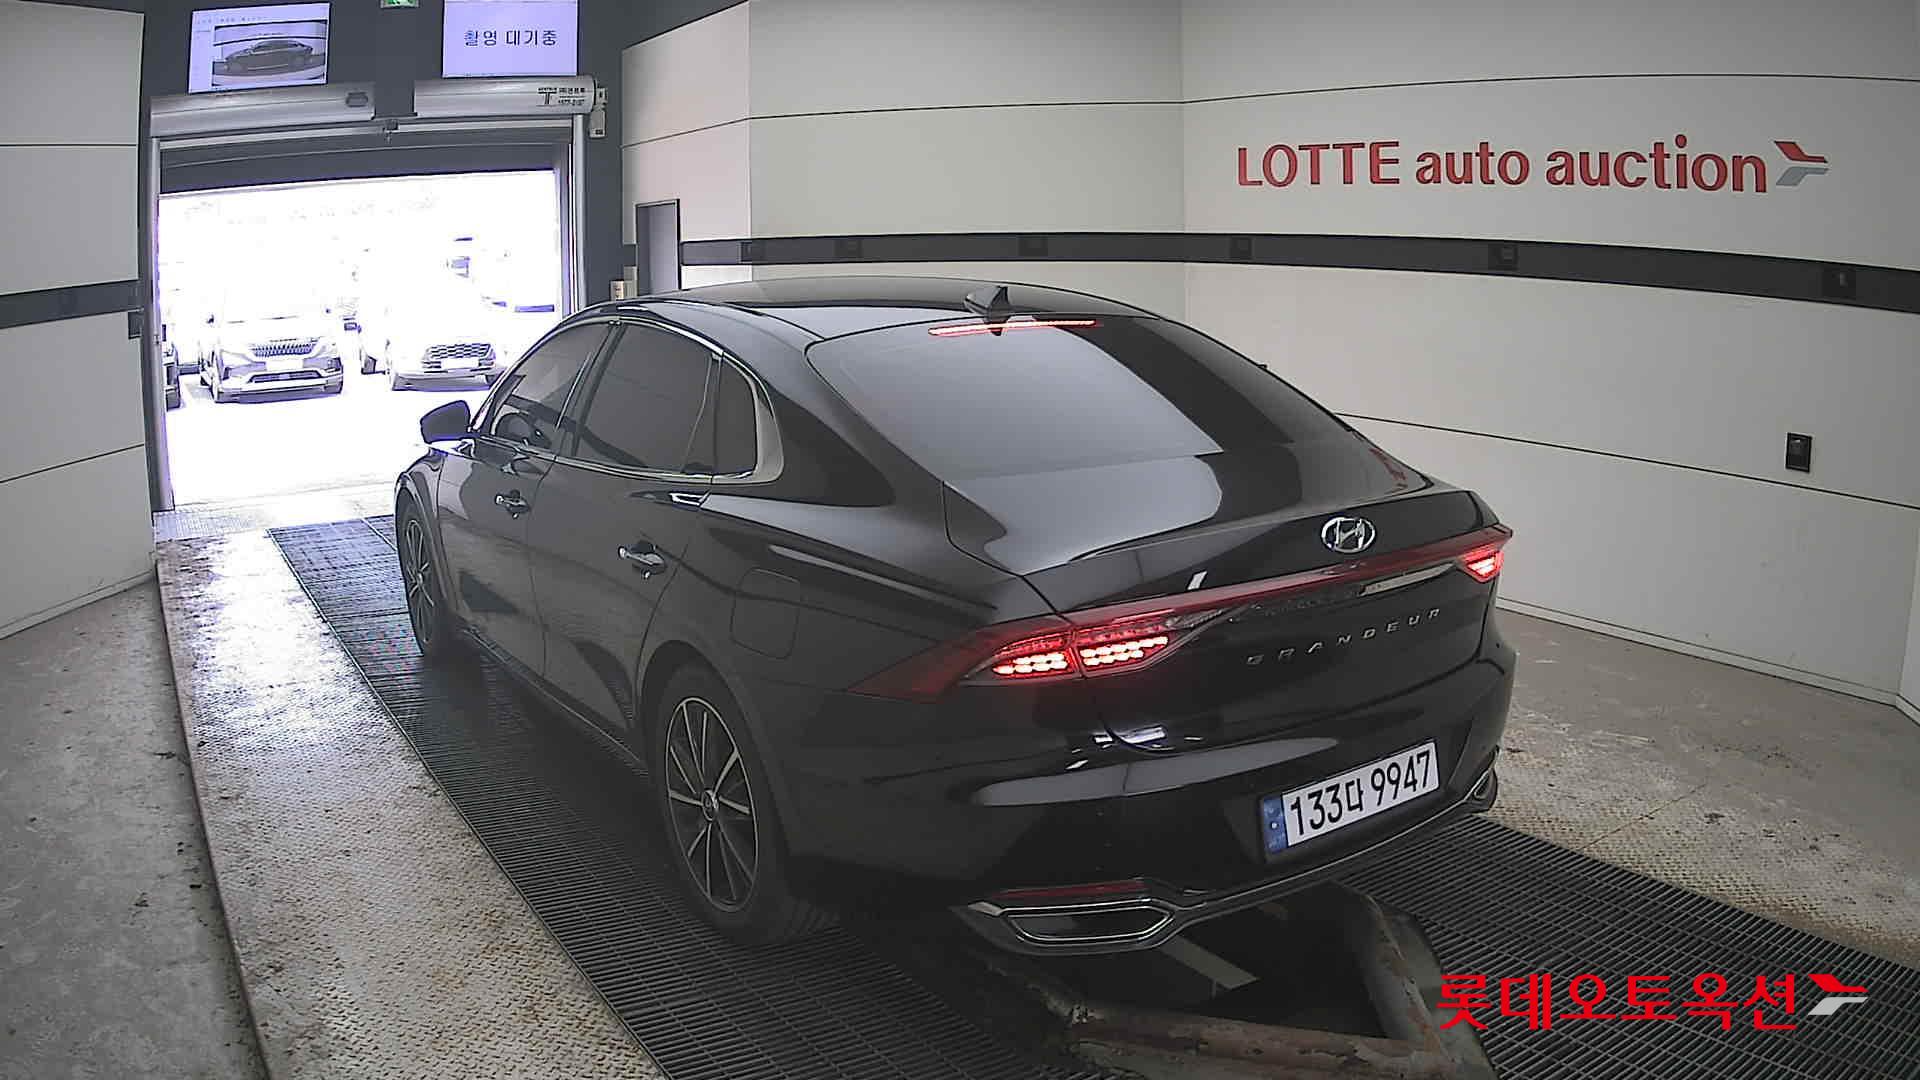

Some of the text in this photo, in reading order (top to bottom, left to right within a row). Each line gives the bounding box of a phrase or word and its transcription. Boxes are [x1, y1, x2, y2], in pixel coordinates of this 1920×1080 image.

[506, 30, 557, 46] 대기중
[1237, 133, 1768, 194] LOTTE auto auction
[1246, 607, 1440, 666] GRANDEUR
[1290, 749, 1431, 836] 133다 9947
